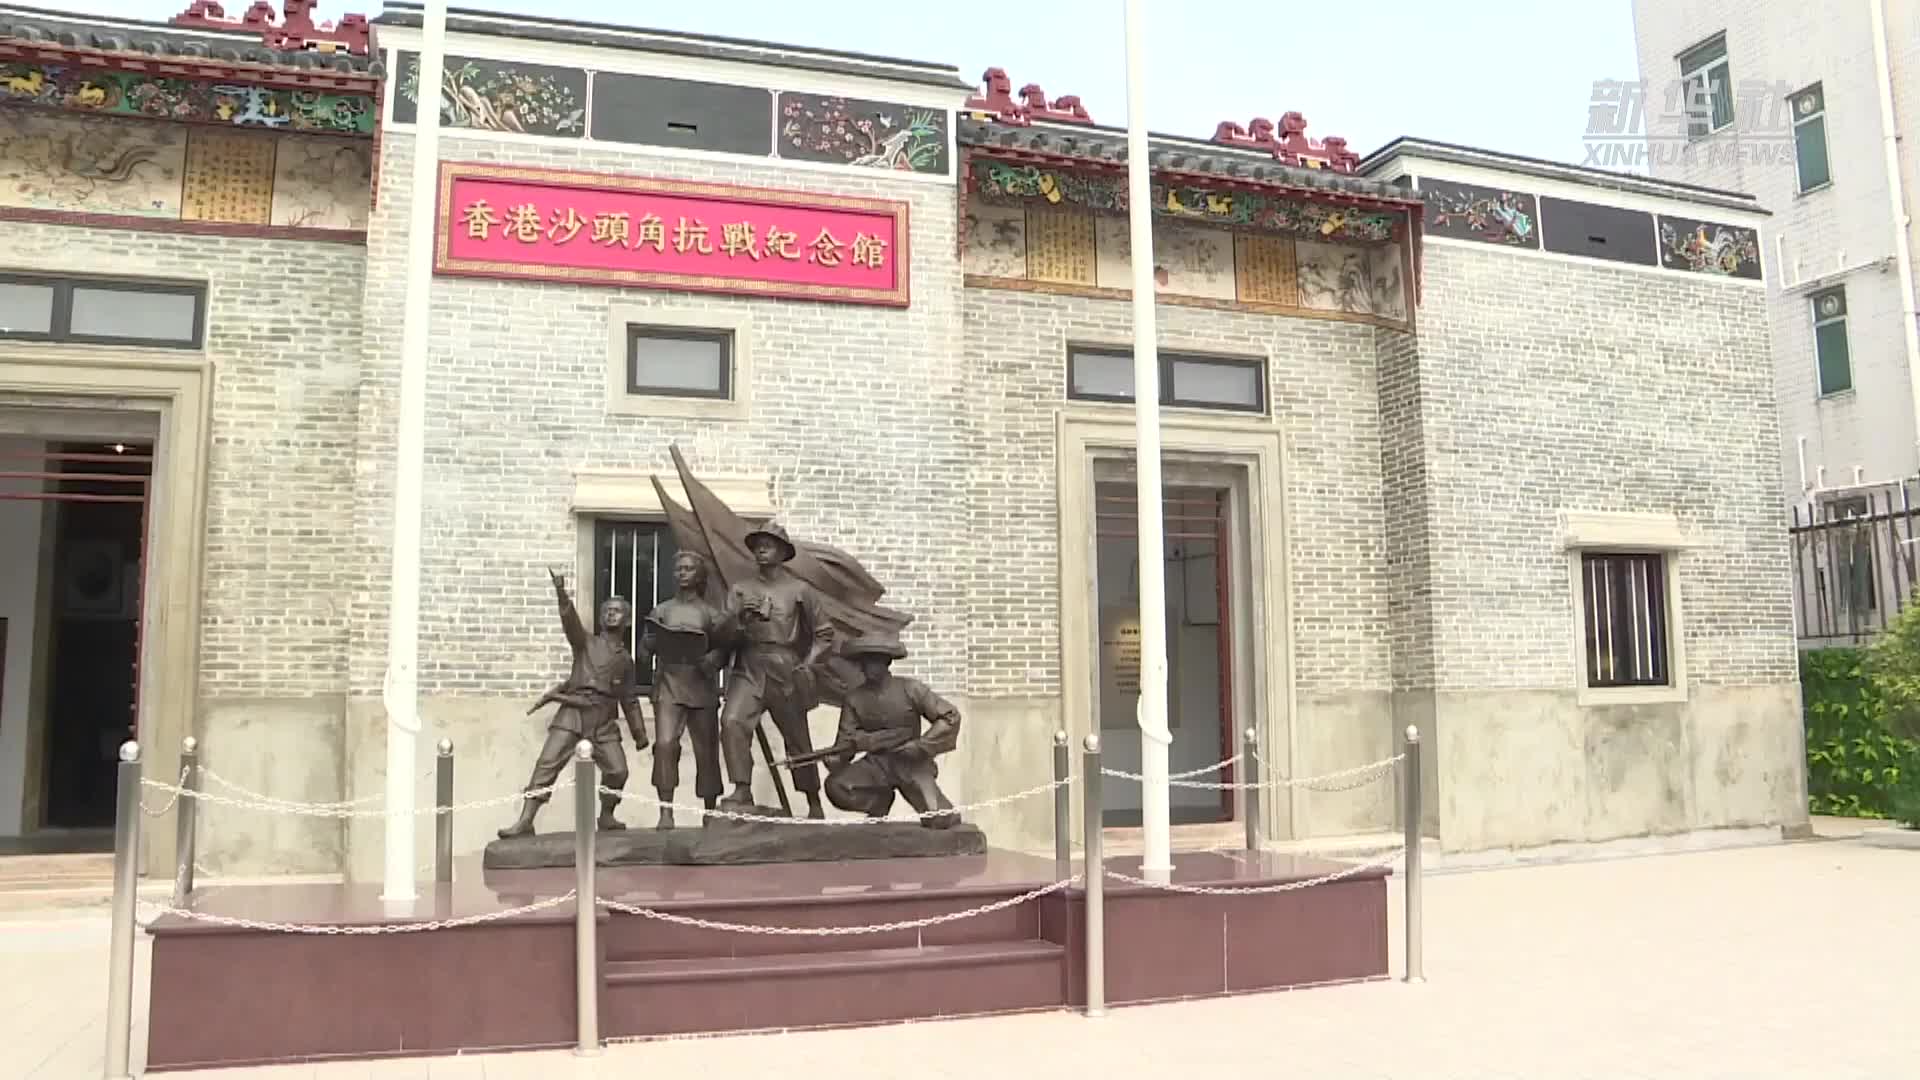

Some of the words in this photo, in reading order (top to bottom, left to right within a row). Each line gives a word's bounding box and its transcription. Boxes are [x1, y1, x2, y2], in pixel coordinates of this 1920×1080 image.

[459, 199, 887, 268] 香港沙頭角抗戰紀念館
